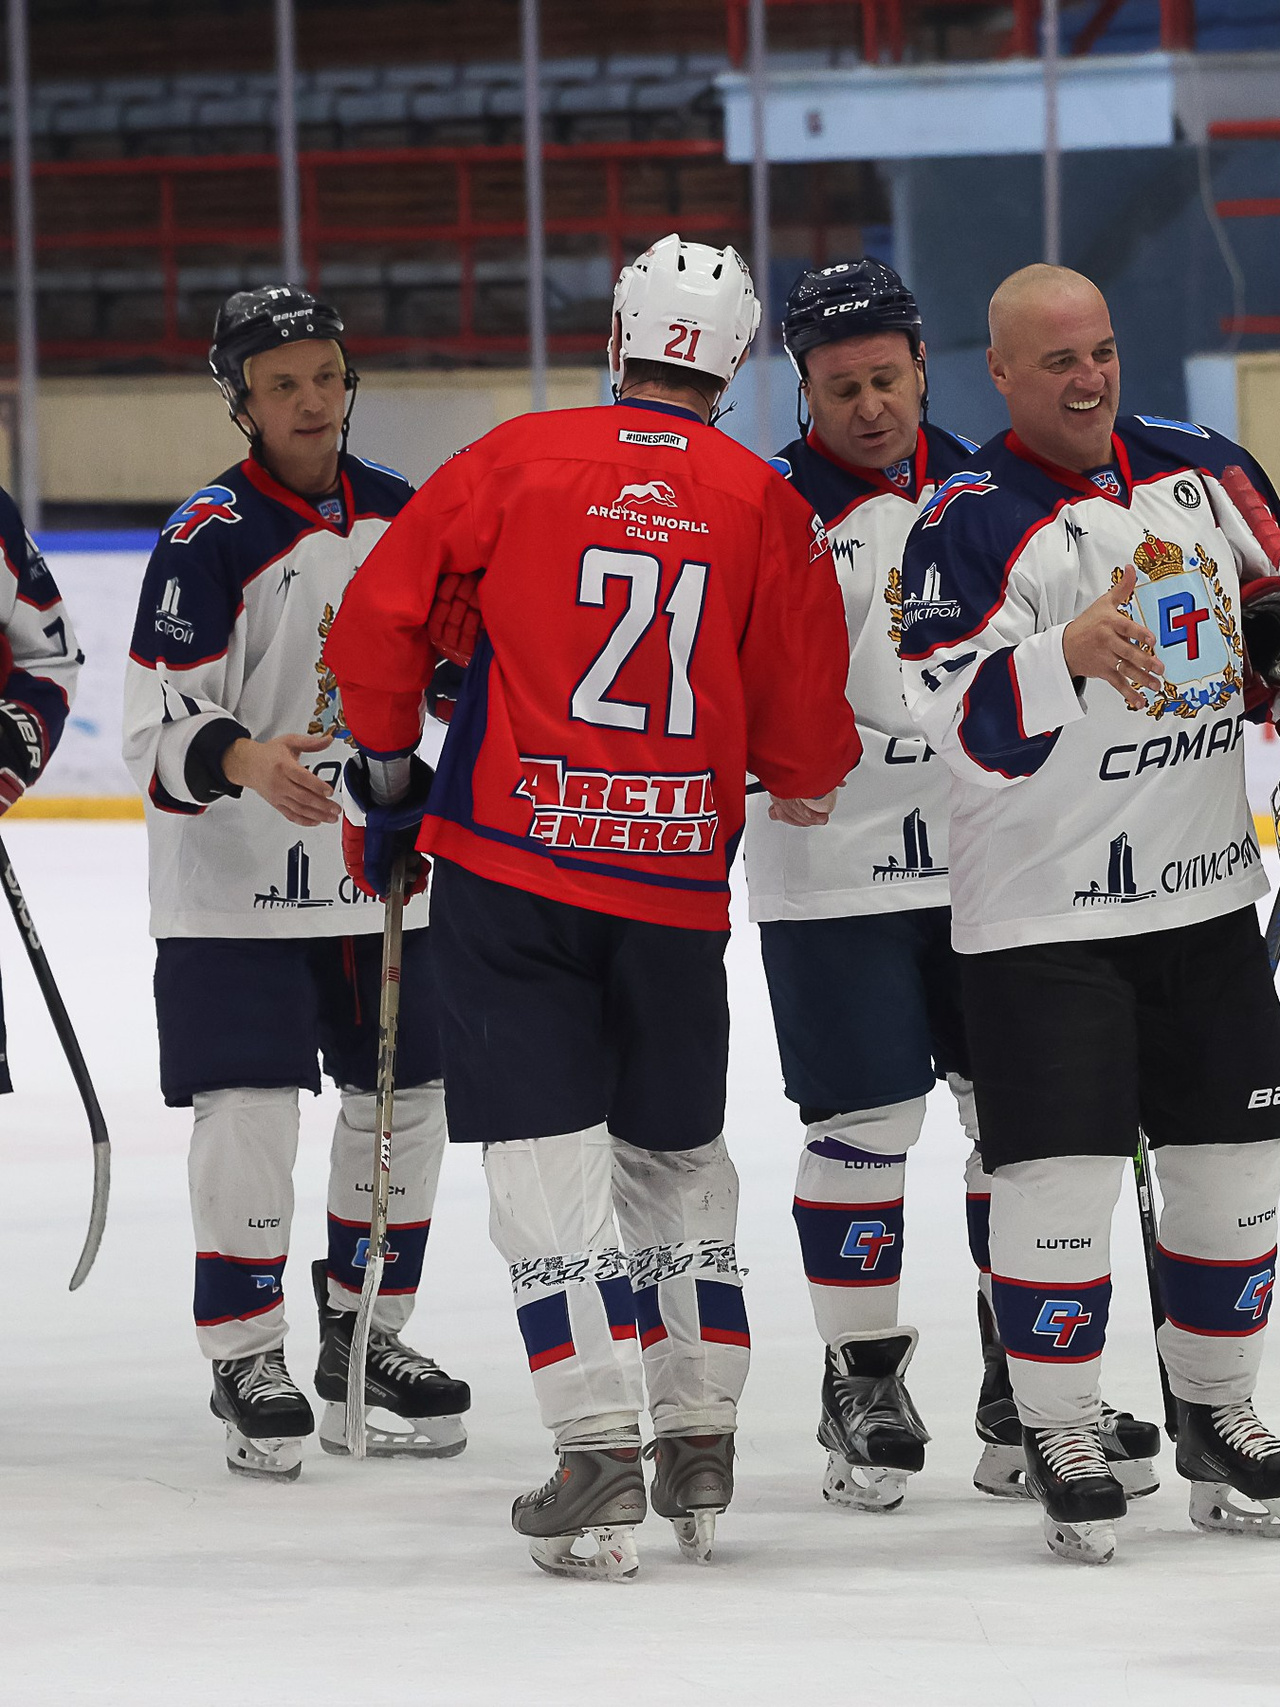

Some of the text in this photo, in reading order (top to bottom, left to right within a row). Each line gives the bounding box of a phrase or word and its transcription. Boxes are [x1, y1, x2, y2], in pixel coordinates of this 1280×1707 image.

[272, 308, 314, 322] BAUER
[823, 299, 870, 317] CCM
[663, 323, 702, 363] 21
[586, 504, 648, 526] ARCTIC
[625, 525, 670, 543] CLUB
[569, 544, 712, 738] 21
[0, 700, 41, 770] UER
[529, 811, 719, 855] ENERGY
[354, 1182, 406, 1196] LUCH
[1236, 1207, 1278, 1228] LUTCH
[1036, 1237, 1092, 1250] LUTCH
